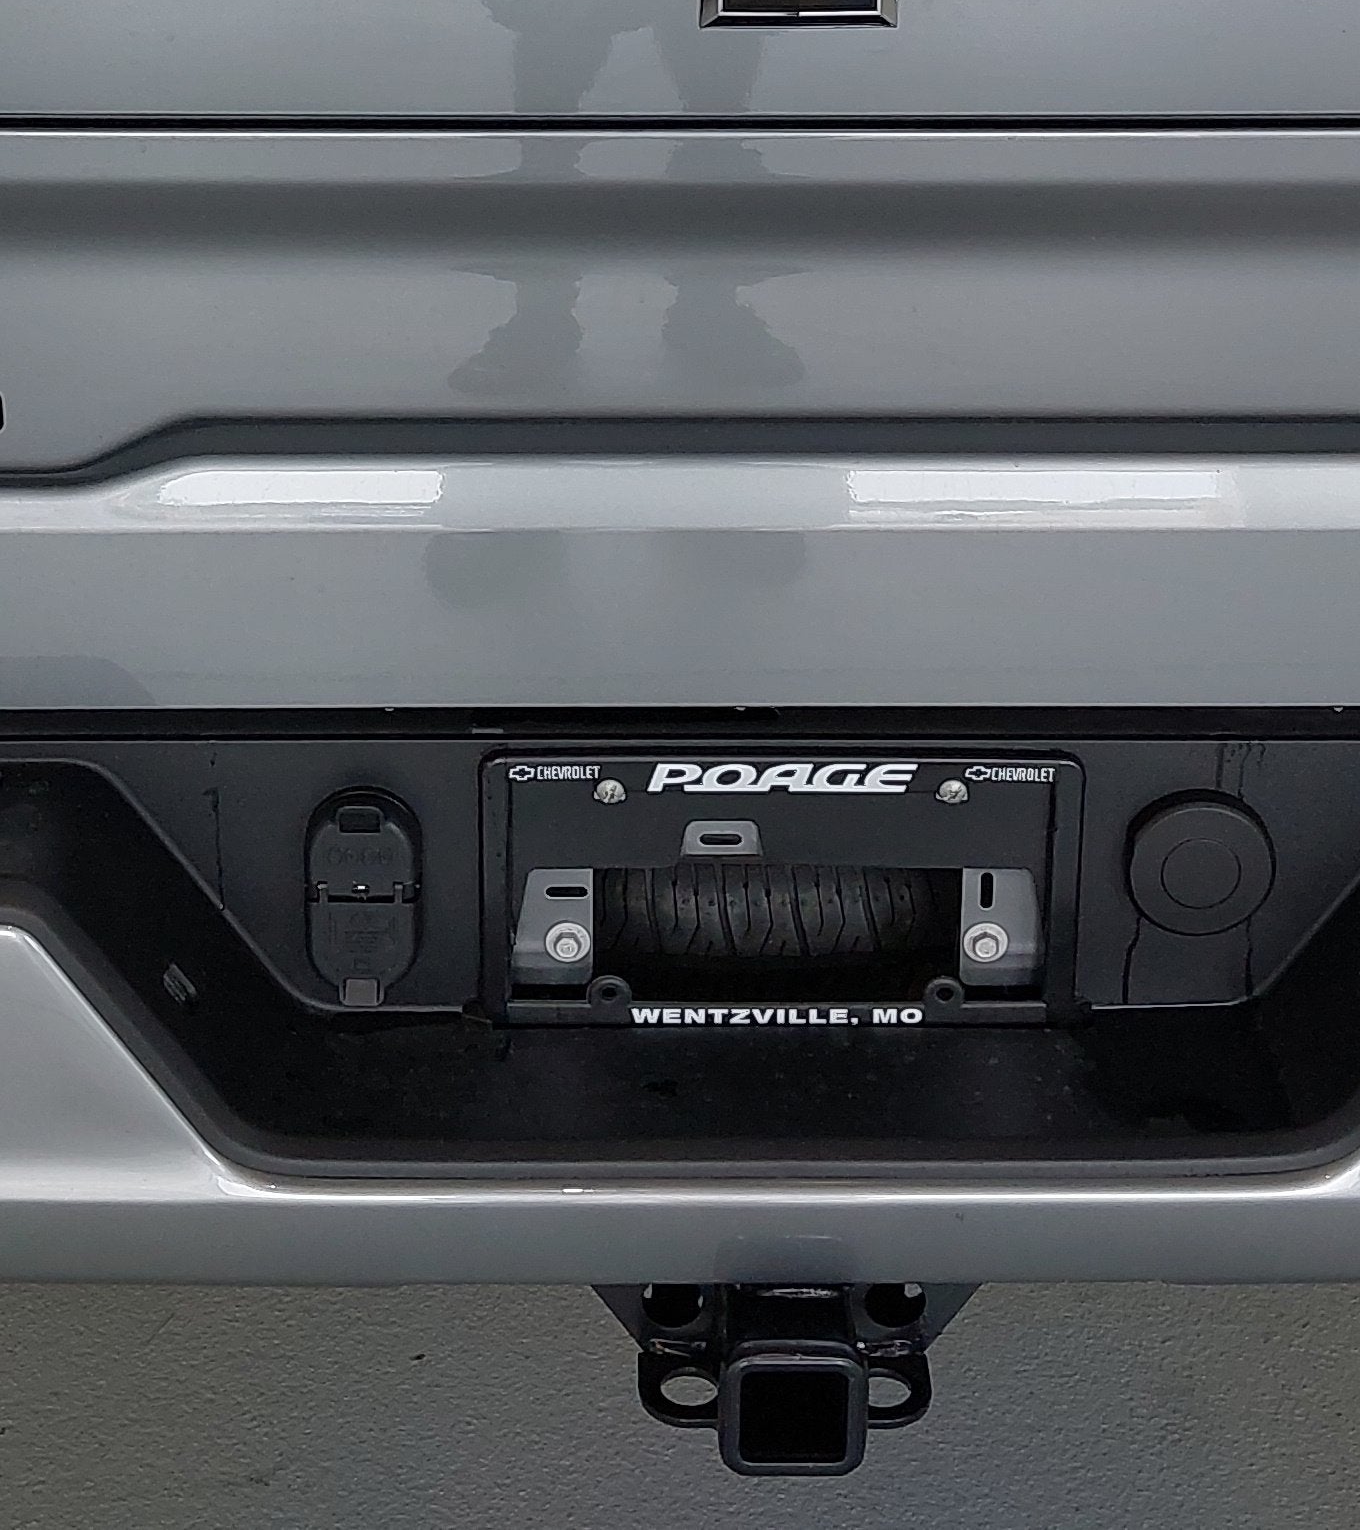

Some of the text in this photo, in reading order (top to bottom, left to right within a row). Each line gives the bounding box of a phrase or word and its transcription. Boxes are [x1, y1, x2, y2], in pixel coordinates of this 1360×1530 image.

[536, 764, 600, 780] CHEVROLET
[647, 763, 918, 793] POAGE
[990, 767, 1055, 783] CHEVROLET
[631, 1007, 924, 1026] WENTZVILLE, MO
